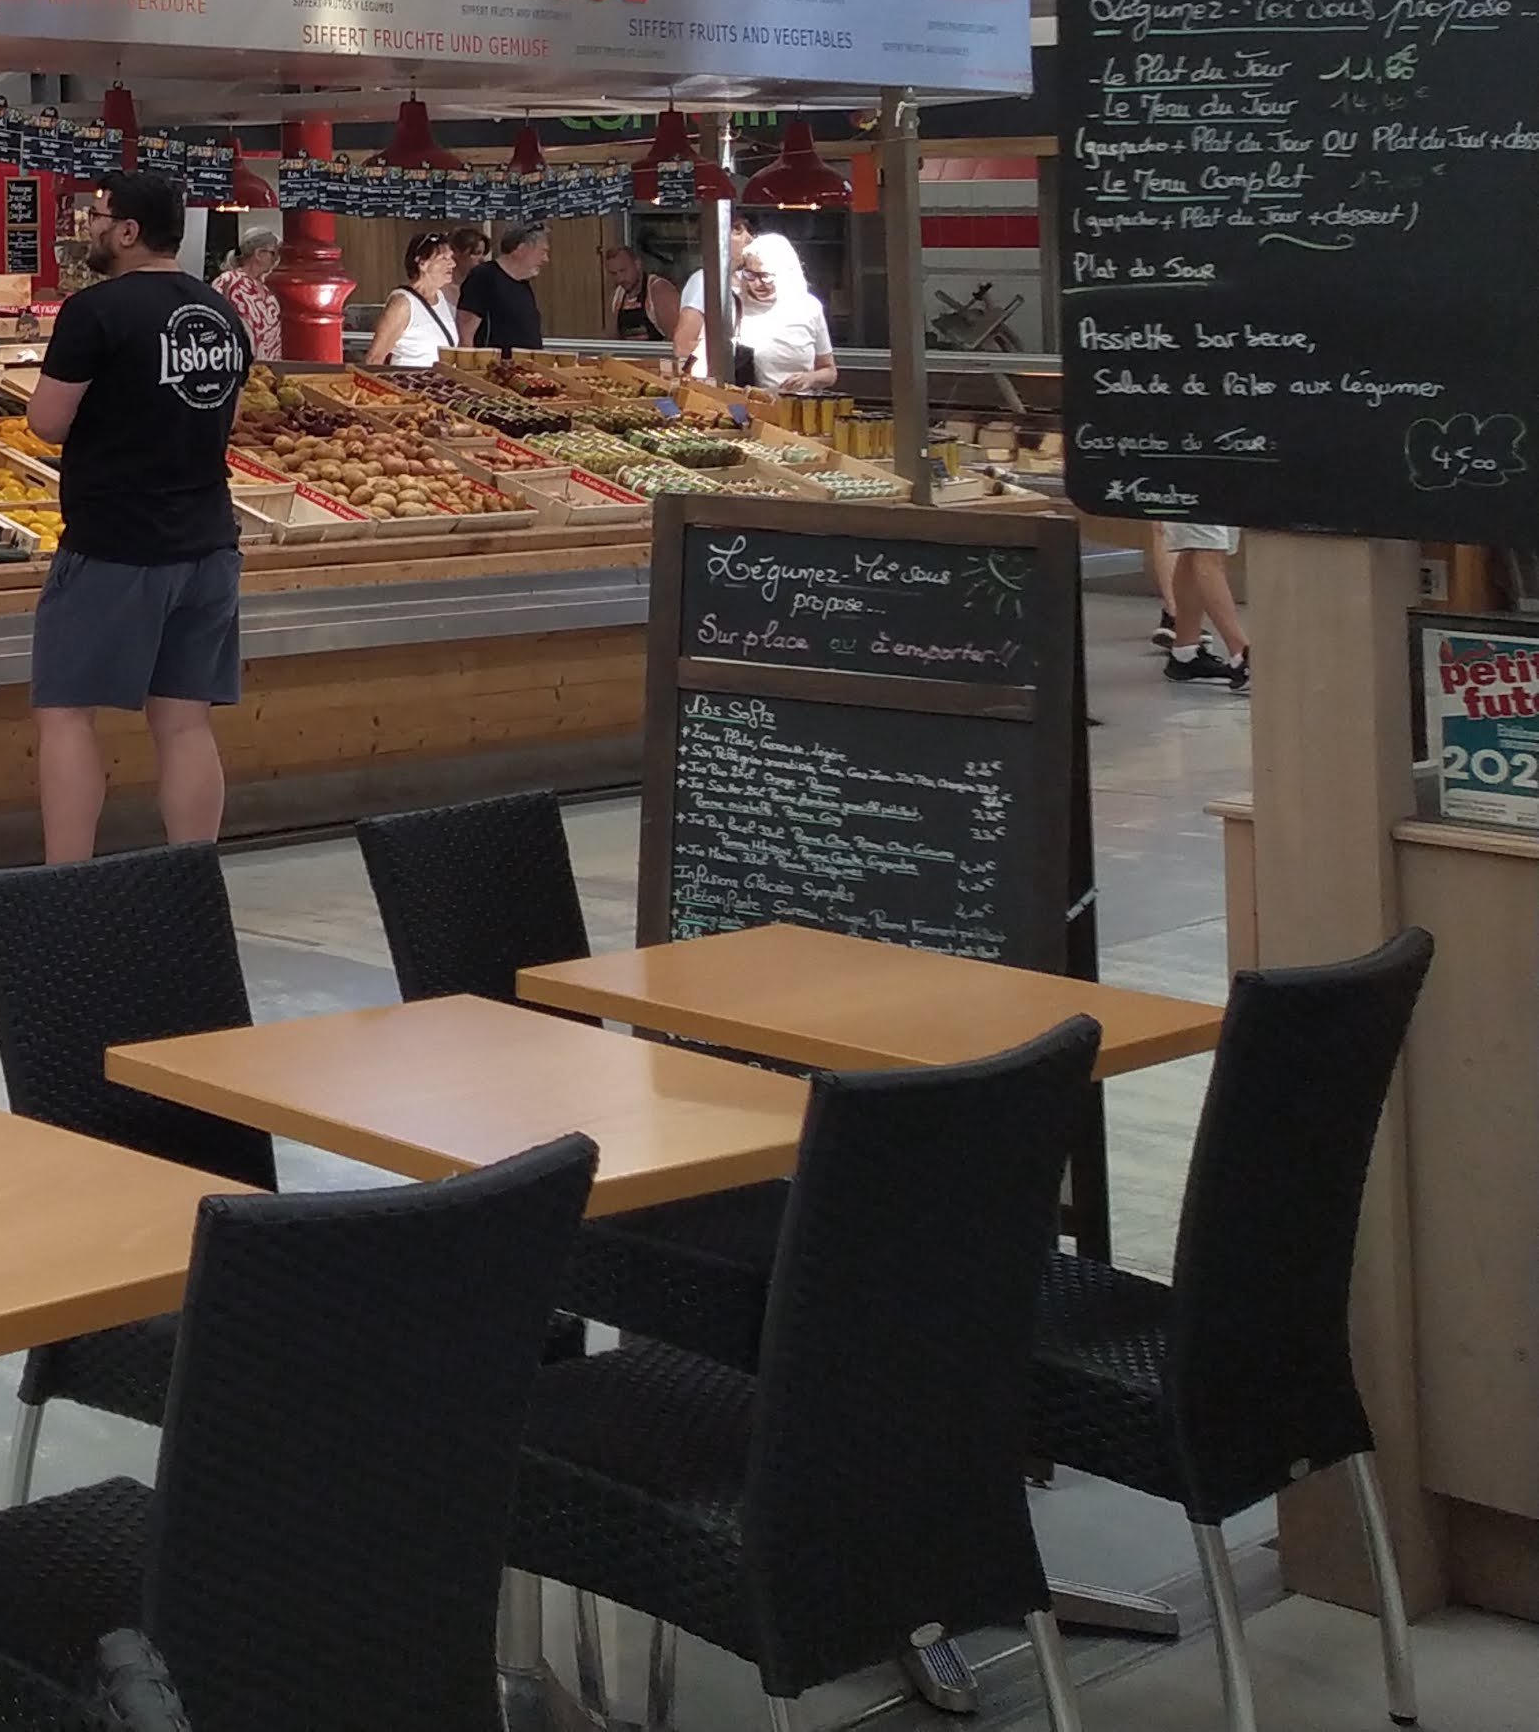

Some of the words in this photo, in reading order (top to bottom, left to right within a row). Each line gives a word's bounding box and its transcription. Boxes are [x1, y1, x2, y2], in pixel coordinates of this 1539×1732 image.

[302, 23, 367, 49] SIFFERT
[374, 29, 444, 51] FRUCHTE
[451, 34, 482, 53] UND
[489, 37, 547, 57] GEMUSE
[629, 18, 684, 38] SIFFERT
[690, 22, 737, 43] FRUITS
[743, 27, 769, 44] AND
[774, 28, 852, 49] VEGETABLES
[158, 332, 244, 385] Lisbeth
